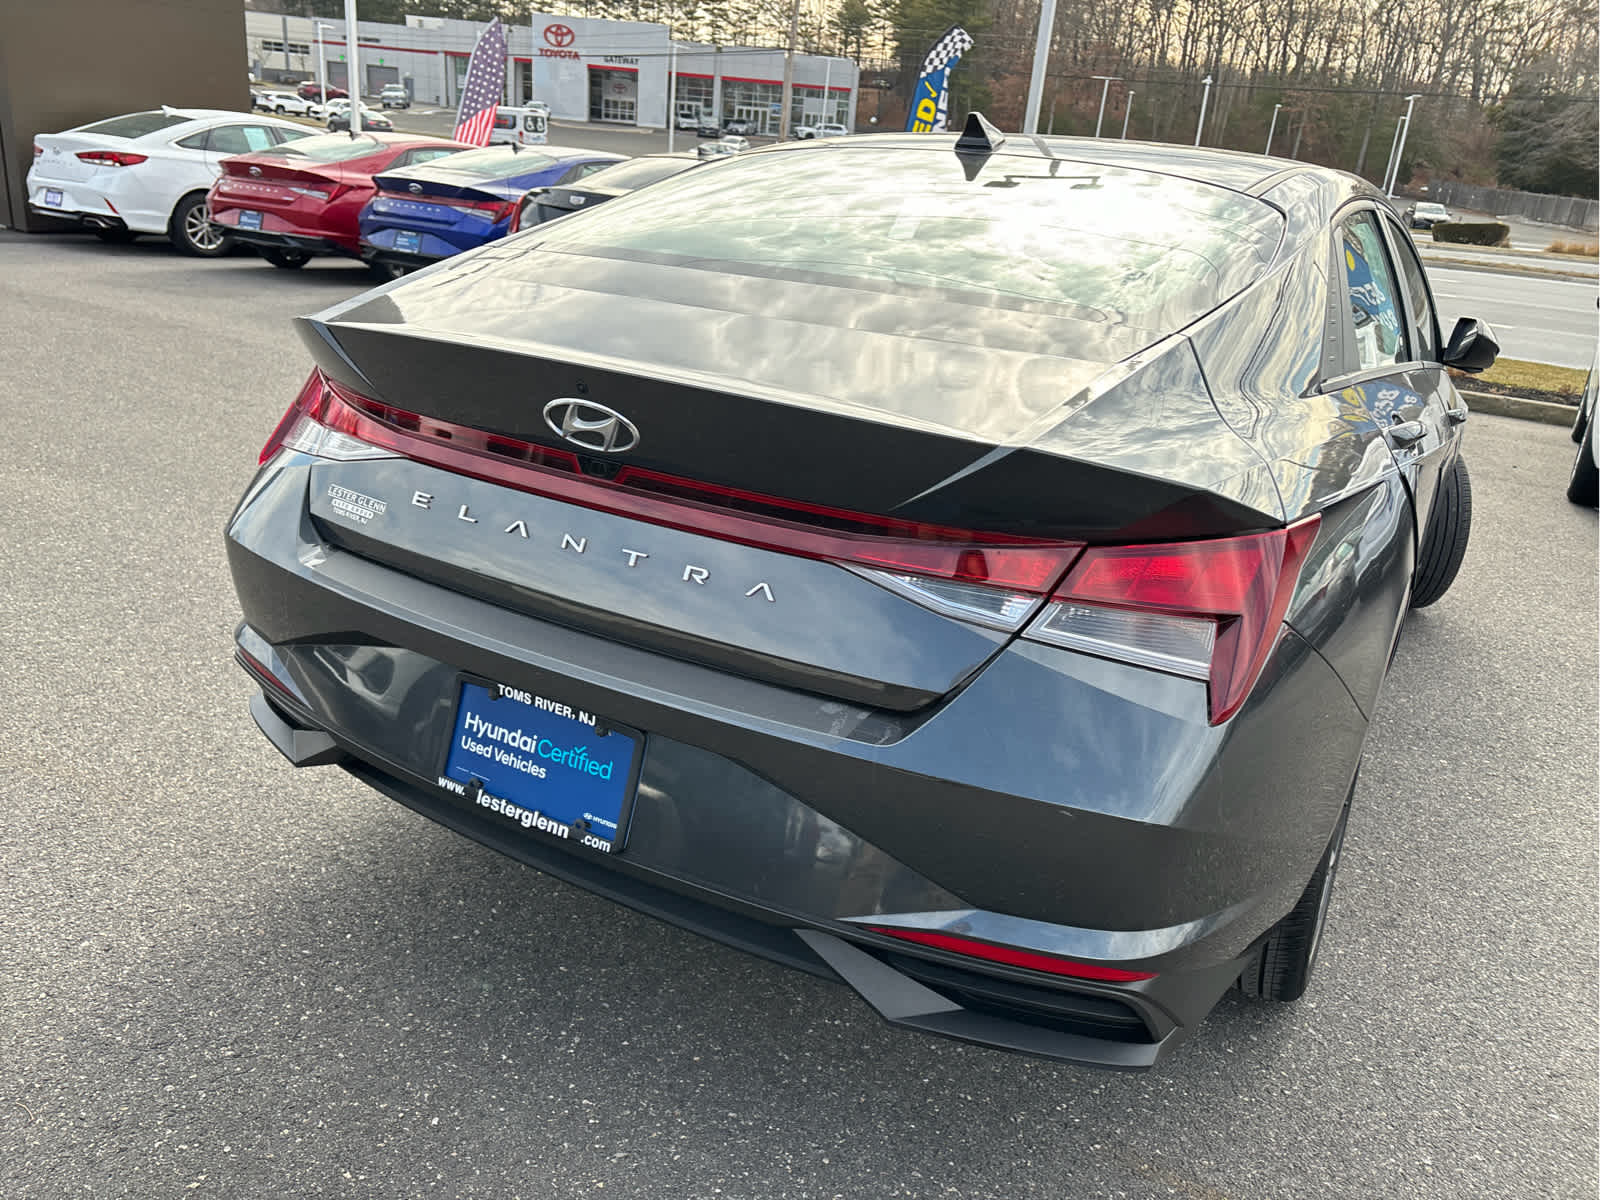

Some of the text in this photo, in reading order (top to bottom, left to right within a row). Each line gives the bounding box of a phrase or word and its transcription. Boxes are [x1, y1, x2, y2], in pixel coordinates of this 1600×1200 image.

[538, 48, 581, 60] TOYOTA
[328, 486, 386, 513] LESTER GLENN
[411, 490, 775, 602] ELANTRA
[498, 683, 596, 727] TOMS RIVER, NJ
[461, 735, 493, 759] Used
[494, 746, 547, 779] Vehicles
[464, 711, 614, 780] Hyundai Certified
[438, 775, 466, 796] www.
[476, 788, 570, 839] lesterglenn
